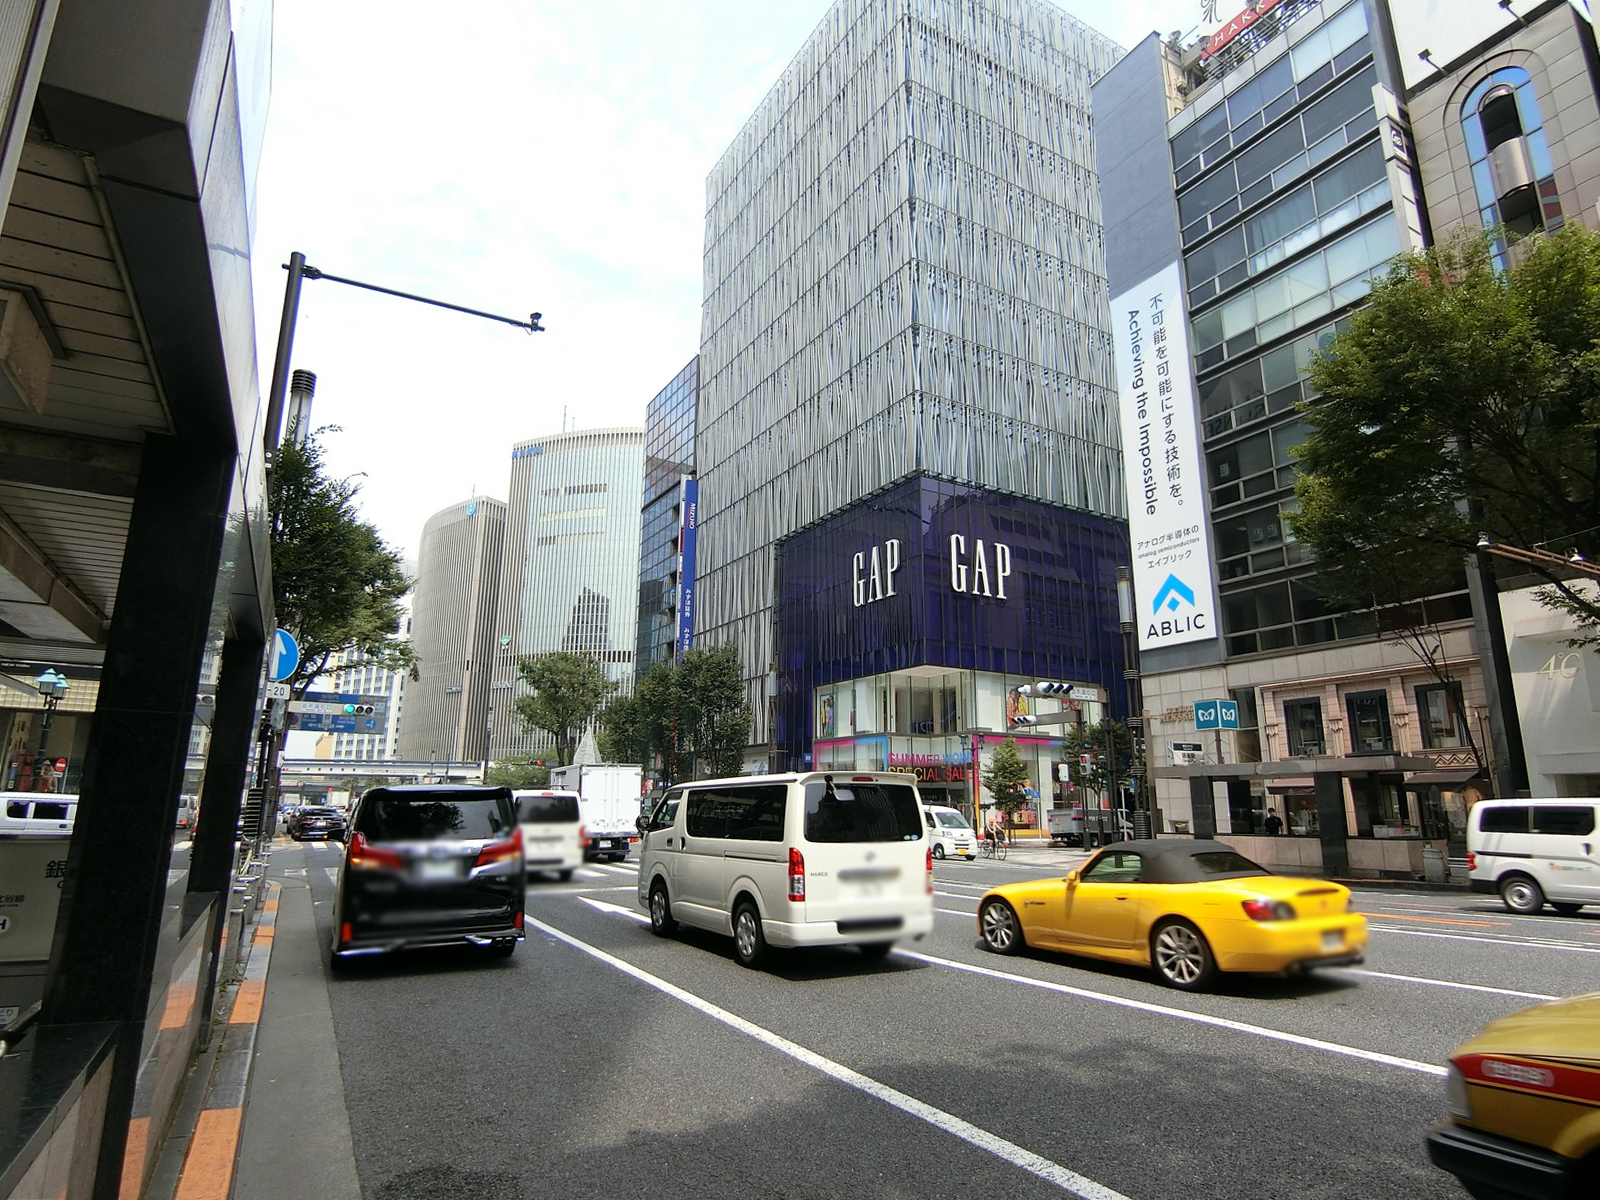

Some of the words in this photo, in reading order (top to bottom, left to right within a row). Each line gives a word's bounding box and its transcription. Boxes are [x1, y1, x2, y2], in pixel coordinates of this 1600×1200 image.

[1128, 309, 1145, 390] Achieving
[1136, 392, 1149, 419] the
[1149, 293, 1183, 506] 不可能を可能にする技術を。
[1138, 423, 1158, 516] Impossible
[950, 533, 1011, 600] GAP
[1137, 524, 1199, 550] アナログ半導体の
[1147, 550, 1192, 569] エイブリック
[853, 538, 900, 607] GAP
[1147, 614, 1205, 639] ABLIC
